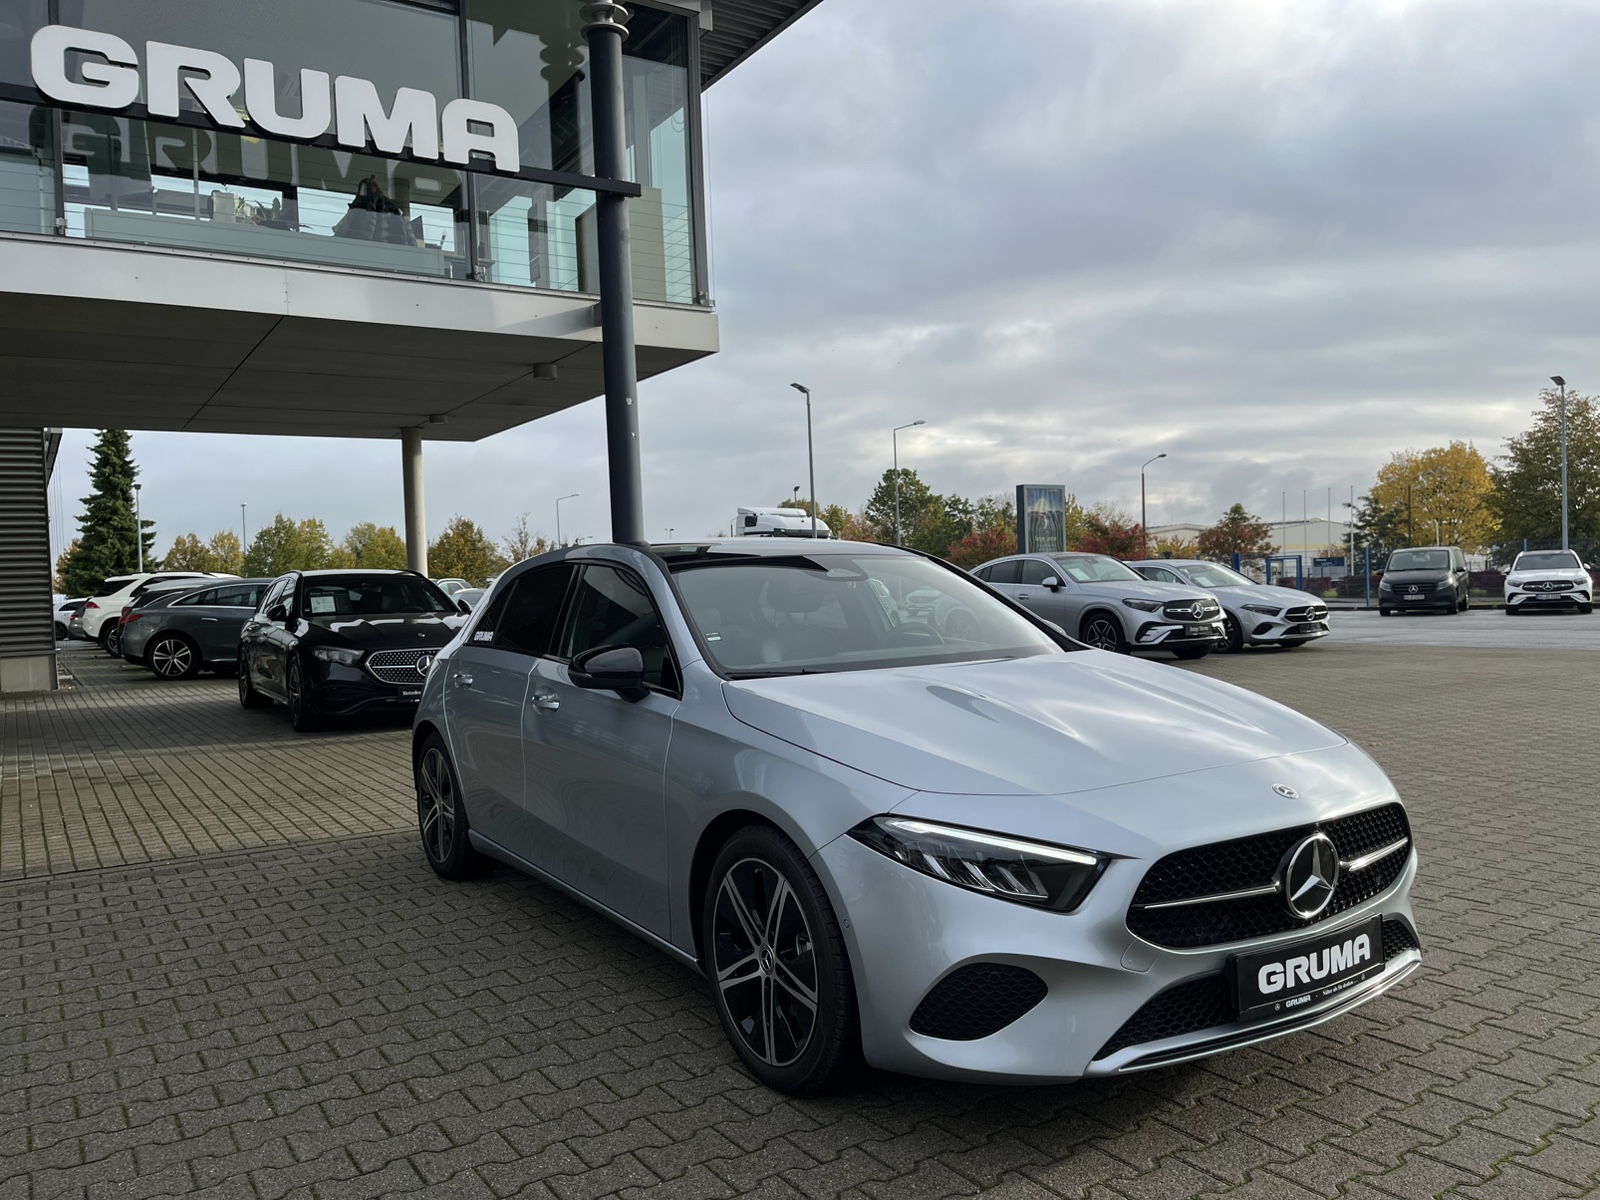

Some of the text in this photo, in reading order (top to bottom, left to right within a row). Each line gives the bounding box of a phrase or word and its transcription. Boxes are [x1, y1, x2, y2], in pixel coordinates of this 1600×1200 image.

[30, 24, 520, 173] GRUMA
[474, 630, 494, 642] GRUMA
[1258, 933, 1371, 994] GRUMA
[1285, 995, 1311, 1008] GRUMA
